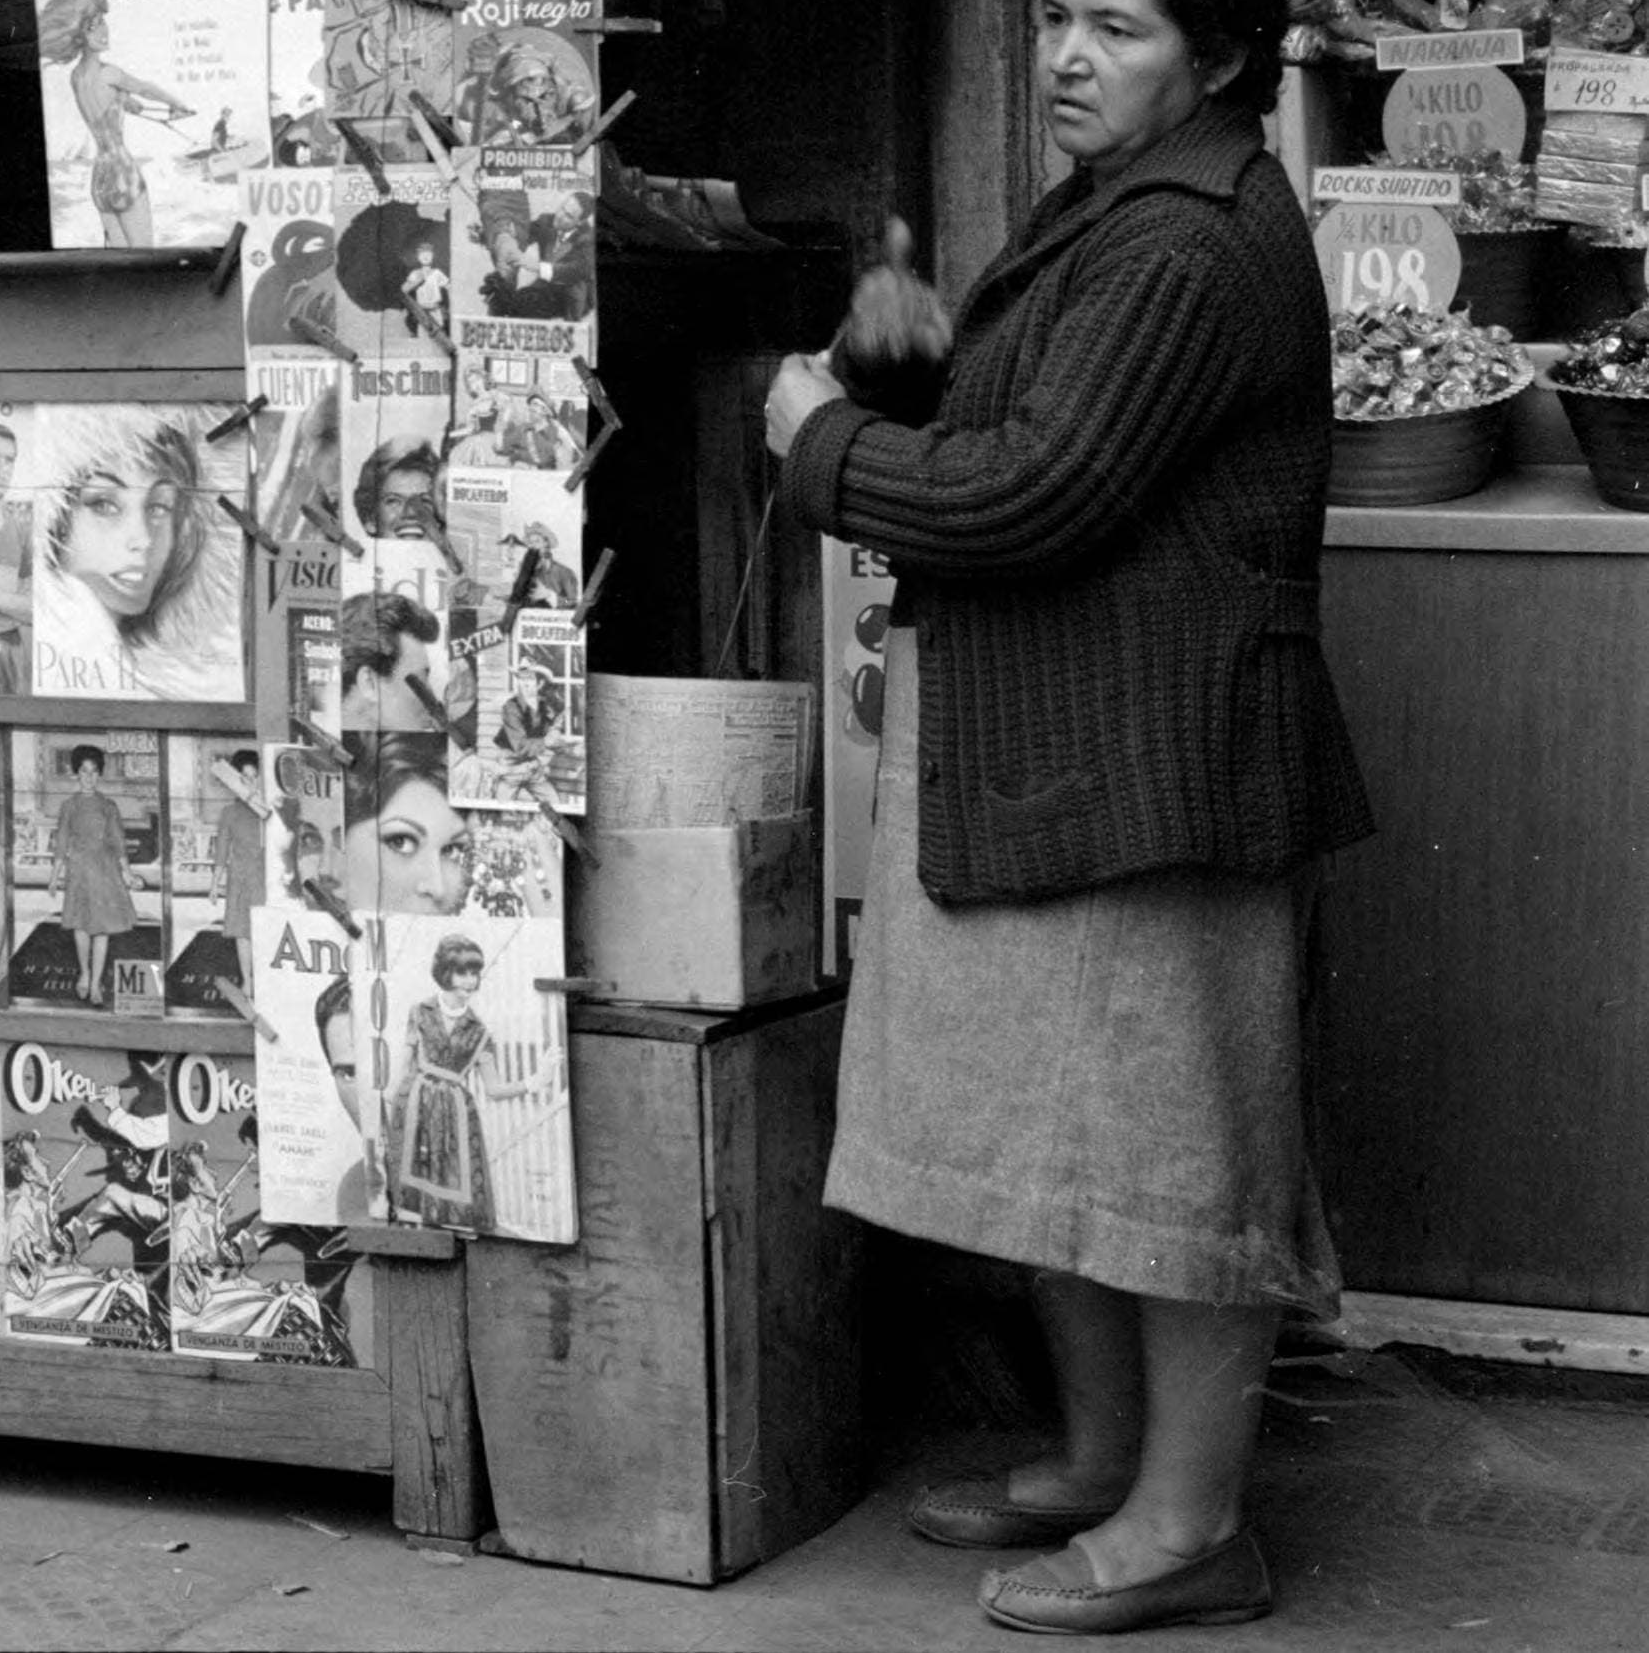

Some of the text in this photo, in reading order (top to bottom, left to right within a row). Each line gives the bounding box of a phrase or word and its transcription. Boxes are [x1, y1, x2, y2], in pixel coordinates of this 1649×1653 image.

[1389, 36, 1507, 64] NARANJA
[1428, 82, 1484, 114] KILO
[1575, 78, 1617, 107] 198
[482, 149, 575, 168] PROHIBIDA
[1317, 173, 1452, 197] ROCKS SURTIDO
[1359, 212, 1425, 246] KILO
[1340, 246, 1432, 314] 198
[449, 625, 504, 658] EXTRA
[9, 1042, 99, 1116] Okey
[18, 1318, 135, 1339] VENGANZA DE MESTIZO
[185, 1333, 304, 1353] VENGANZA DE MESTIZO
